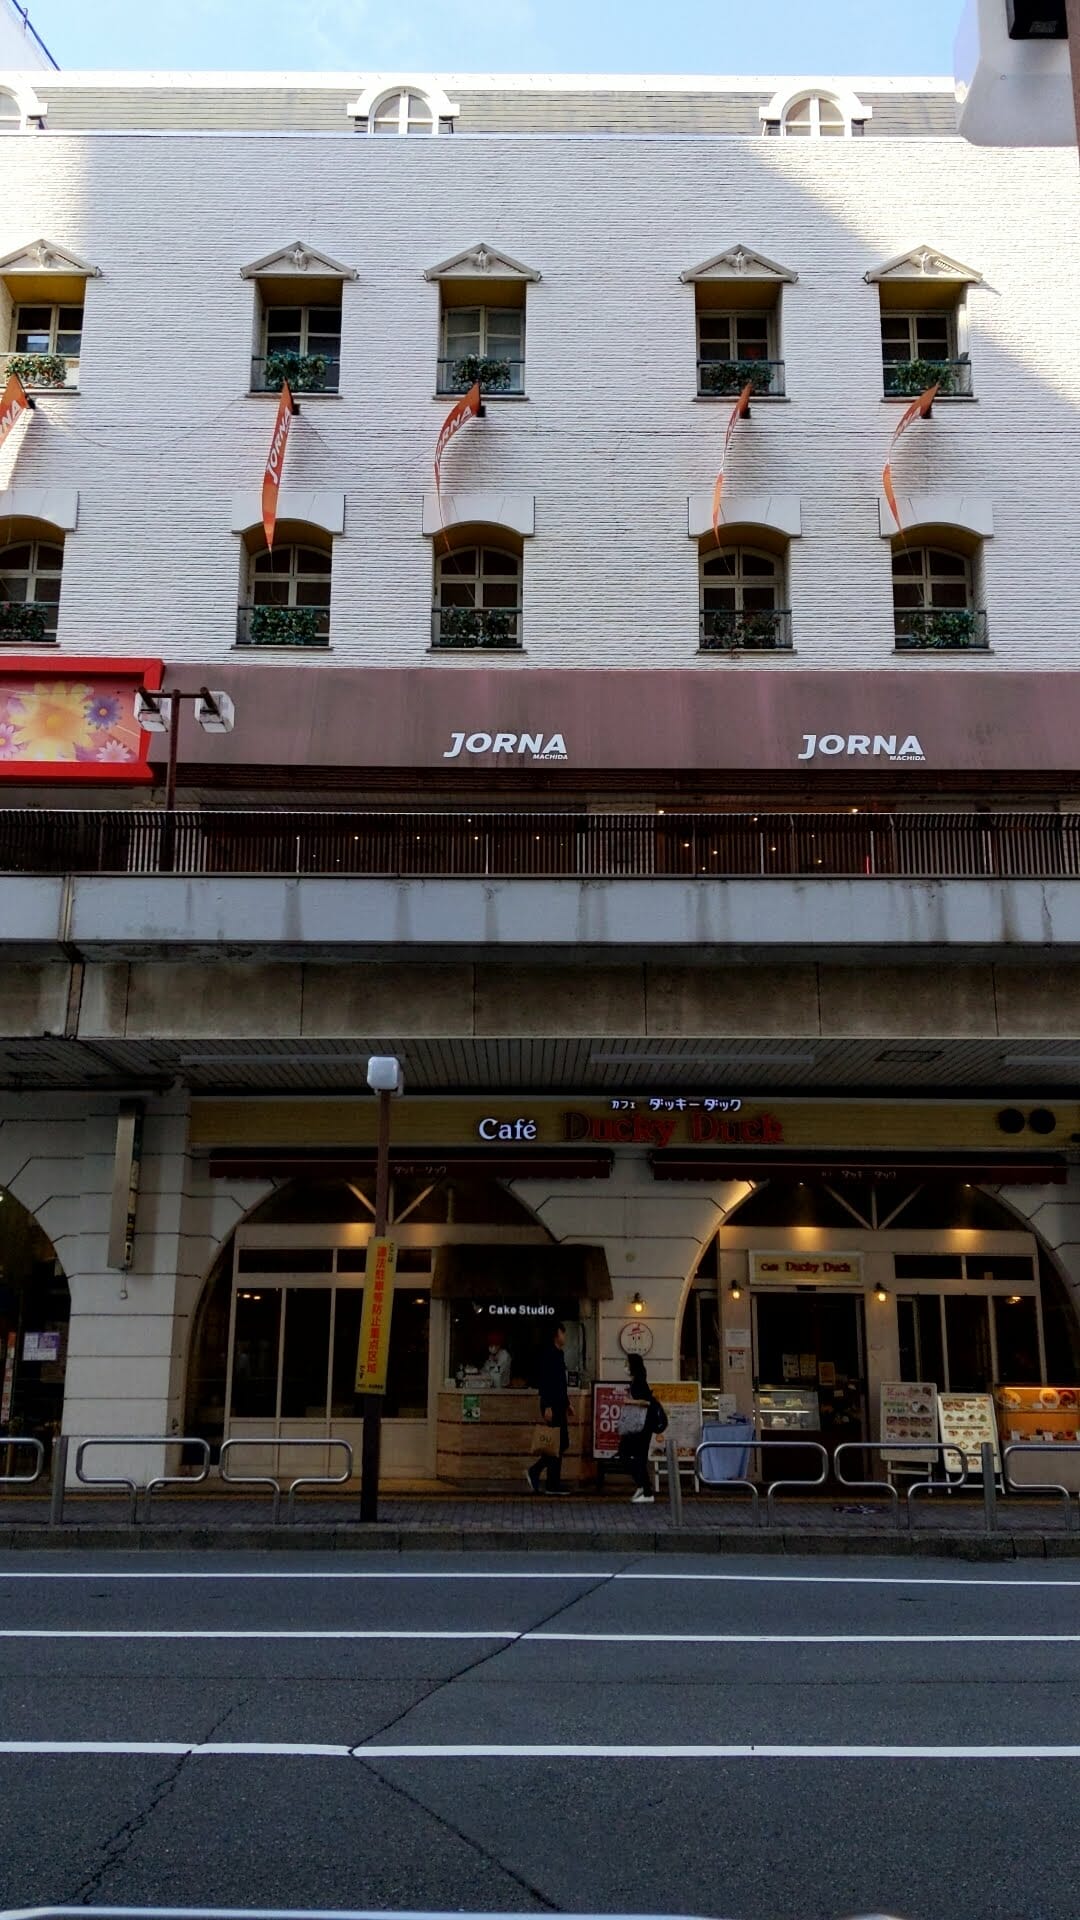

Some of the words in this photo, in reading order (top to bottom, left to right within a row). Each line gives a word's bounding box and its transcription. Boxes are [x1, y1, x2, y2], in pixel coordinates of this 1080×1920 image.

[265, 405, 292, 486] JORNA
[442, 732, 568, 758] JORNA
[796, 734, 925, 760] JORNA
[610, 1100, 637, 1110] カフェ
[478, 1117, 537, 1141] Café
[565, 1112, 675, 1148] Ducky
[691, 1112, 784, 1143] Duck
[488, 1304, 517, 1316] Cake
[519, 1304, 555, 1316] Studio
[599, 1404, 622, 1420] 20
[599, 1420, 619, 1433] OF
